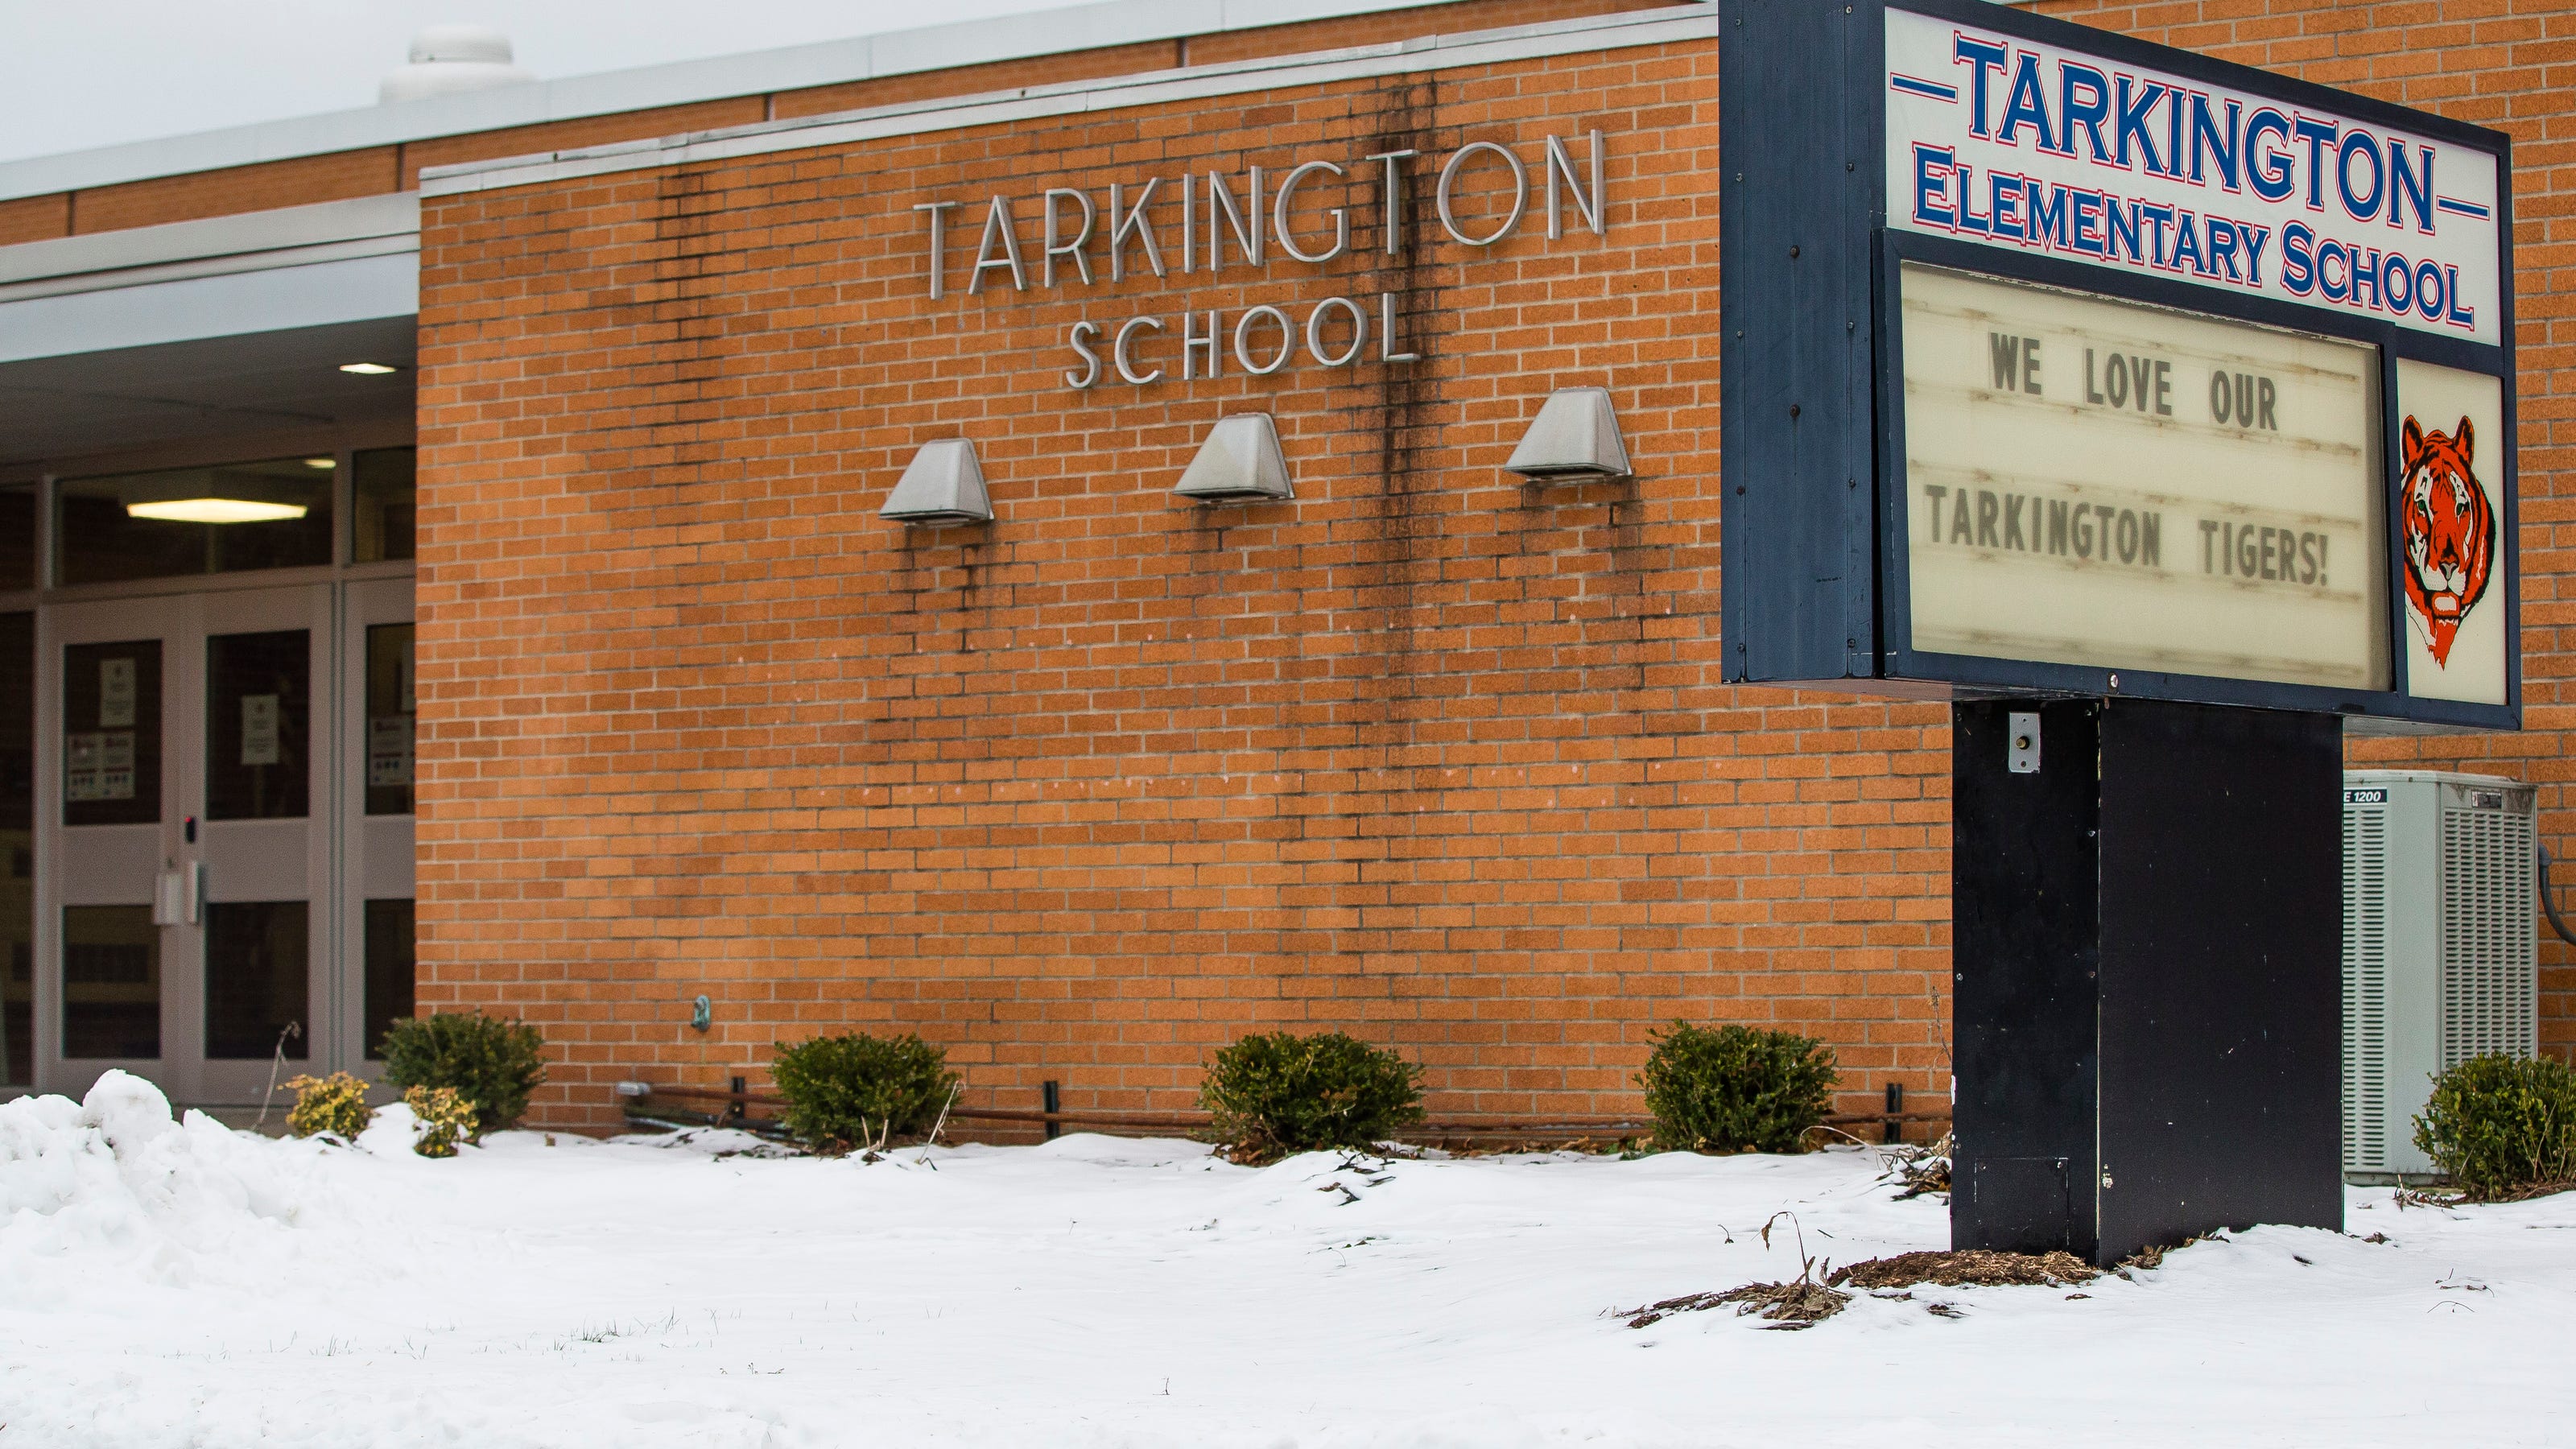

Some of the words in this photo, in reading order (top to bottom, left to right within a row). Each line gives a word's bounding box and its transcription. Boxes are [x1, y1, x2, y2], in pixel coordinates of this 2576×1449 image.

[1953, 31, 2435, 236] TARKINGTON
[913, 129, 1606, 300] TARKINGTON
[1911, 142, 2271, 288] ELEMENTARY
[2281, 221, 2475, 332] SCHOOL
[1065, 293, 1421, 389] SCHOOL
[1990, 332, 2042, 394] WE
[2084, 347, 2173, 415] LOVE
[2210, 369, 2277, 431] OUR
[1923, 484, 2161, 567] TARKINGTON
[2198, 519, 2329, 586] TIGERS!
[2354, 791, 2381, 802] 1200
